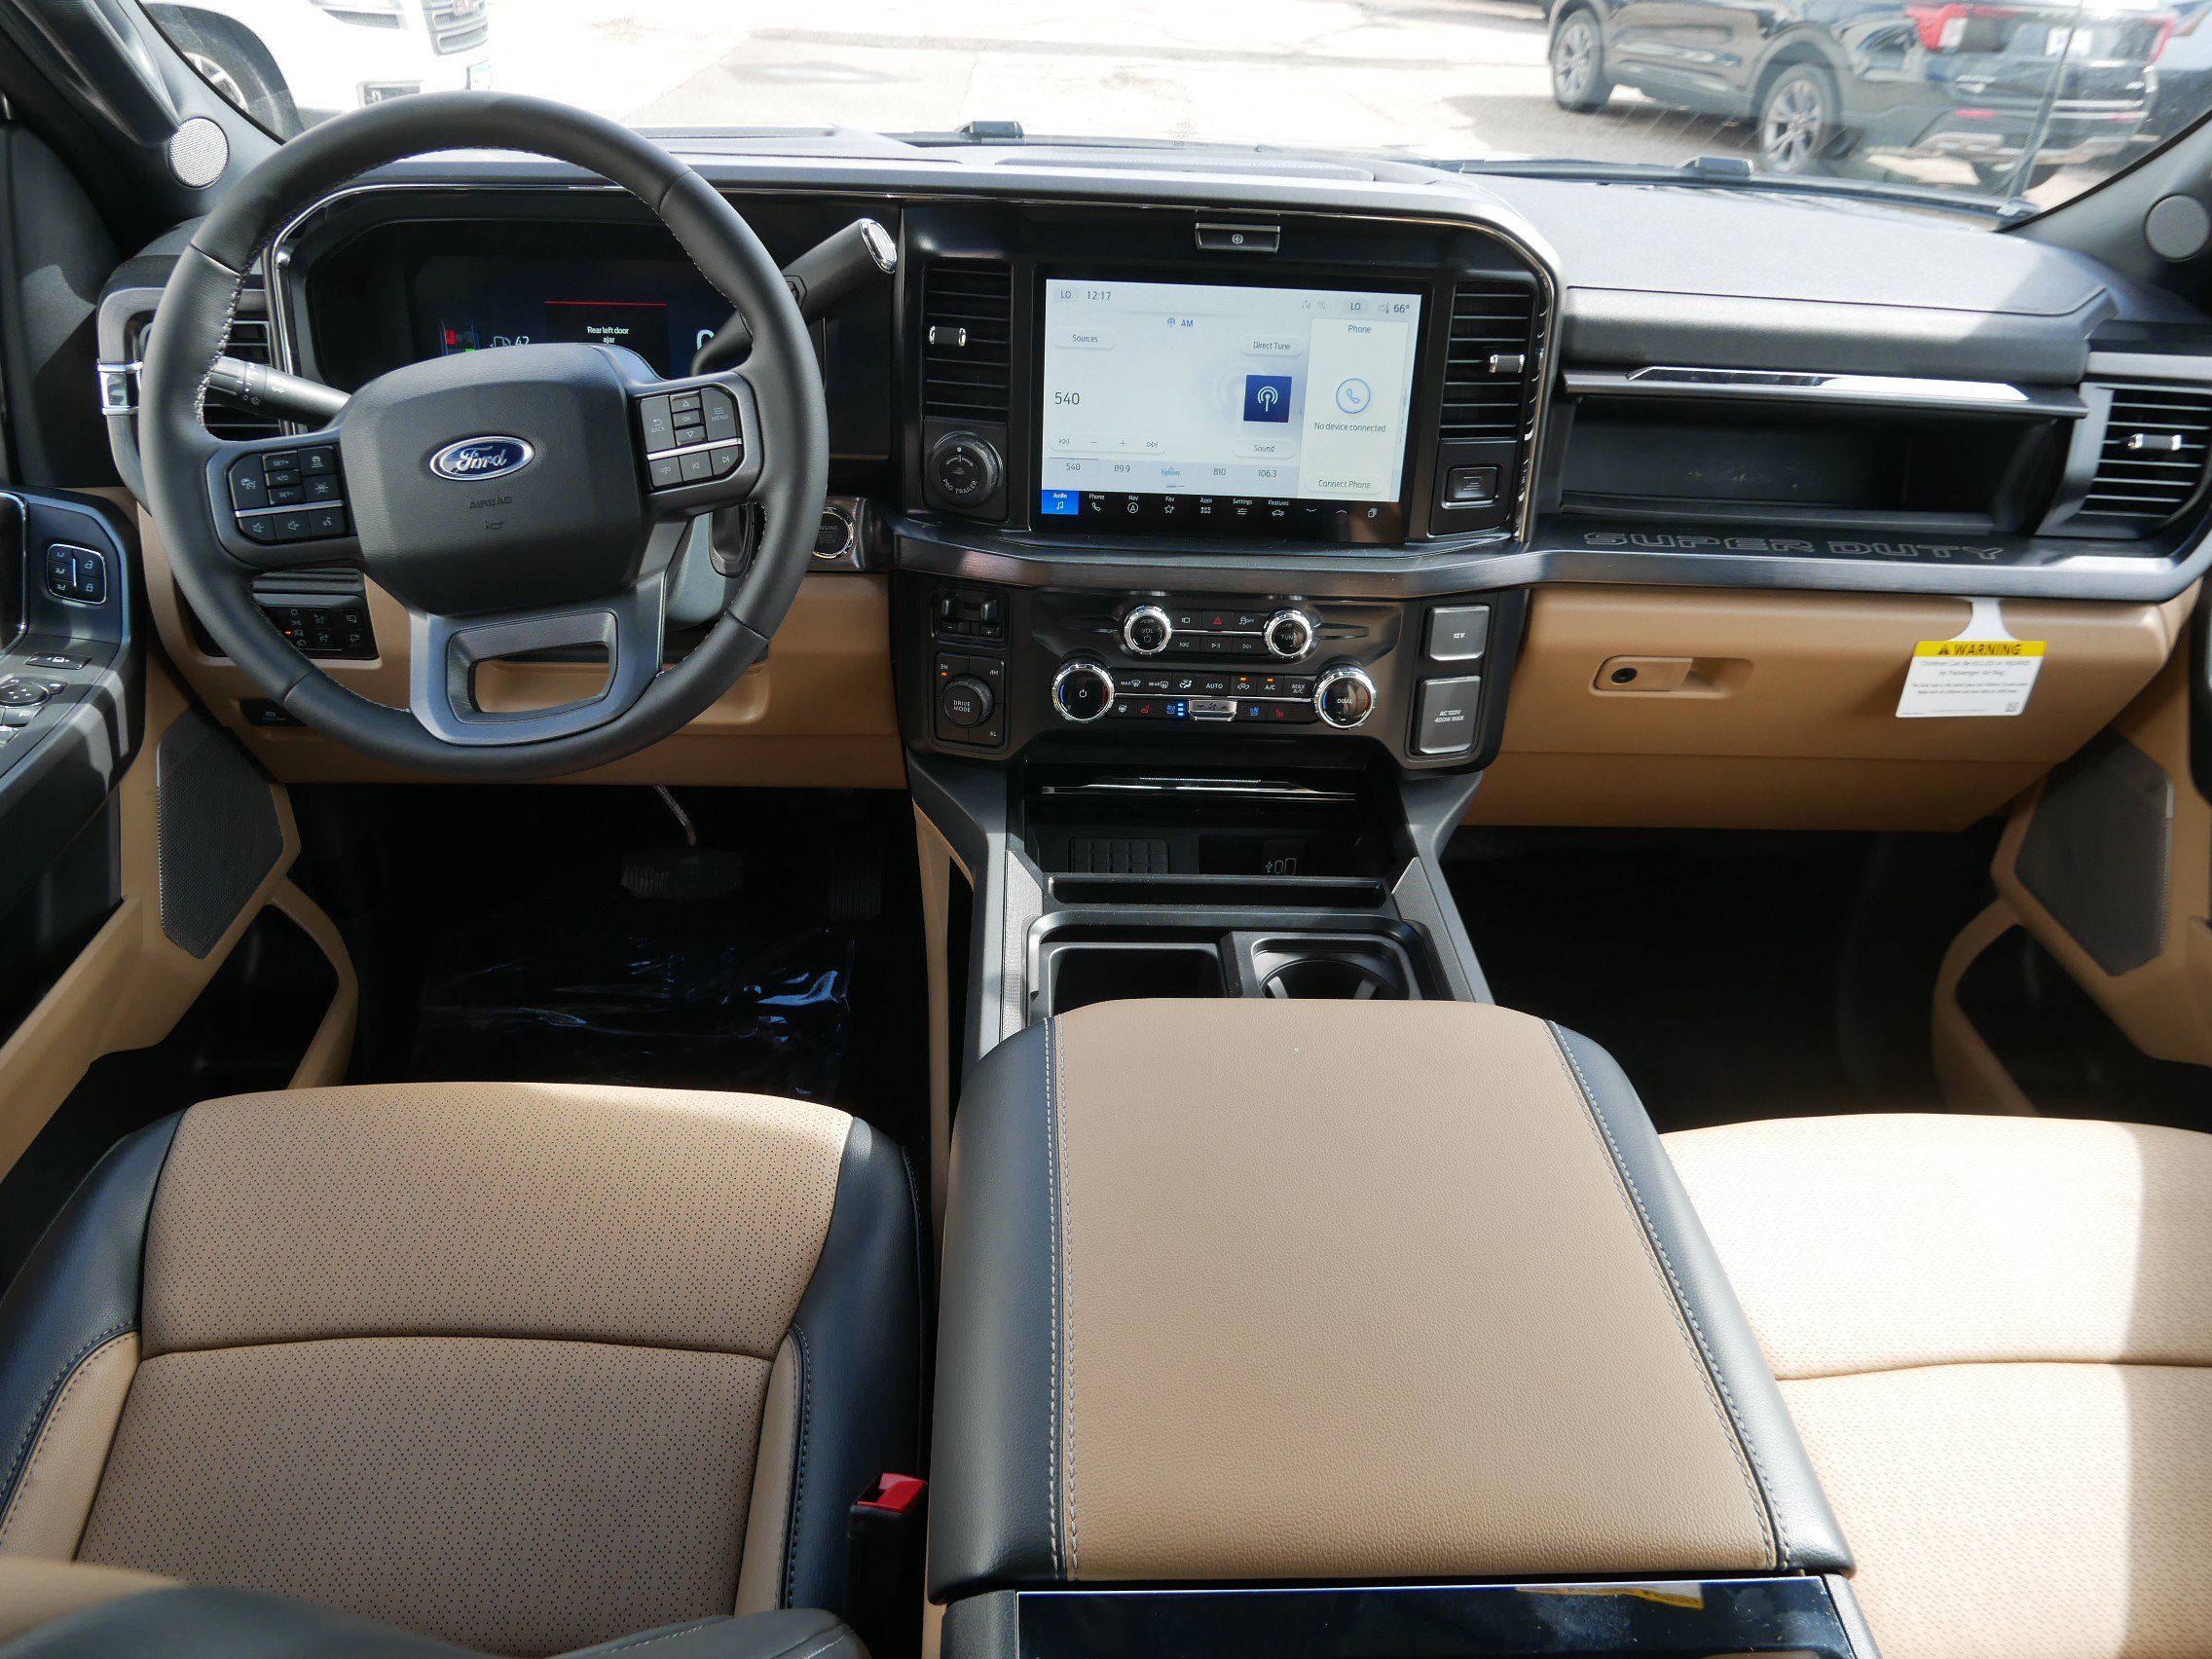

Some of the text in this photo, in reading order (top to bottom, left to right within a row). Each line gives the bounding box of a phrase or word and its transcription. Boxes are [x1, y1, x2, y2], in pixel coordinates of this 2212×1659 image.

[1087, 291, 1112, 301] 12:17
[1350, 302, 1361, 311] LO
[1393, 304, 1410, 313] 66°
[1180, 319, 1194, 328] AM
[1347, 324, 1372, 334] Phone
[1072, 334, 1099, 343] Sources
[1253, 341, 1291, 350] Direct Tune
[1054, 391, 1081, 405] 540
[1326, 423, 1348, 431] device
[1253, 444, 1275, 453] Sound
[455, 445, 508, 472] Ford
[1066, 462, 1081, 471] 540
[1114, 464, 1131, 473] 89.9
[1213, 467, 1227, 476] 810
[1258, 469, 1277, 478] 106.3
[942, 478, 978, 495] PRO TRAILER
[1318, 480, 1372, 489] Connect Phone
[468, 496, 513, 509] AIRBAG
[1584, 532, 2005, 560] SUPER DUTY
[1953, 644, 2022, 655] WARNING
